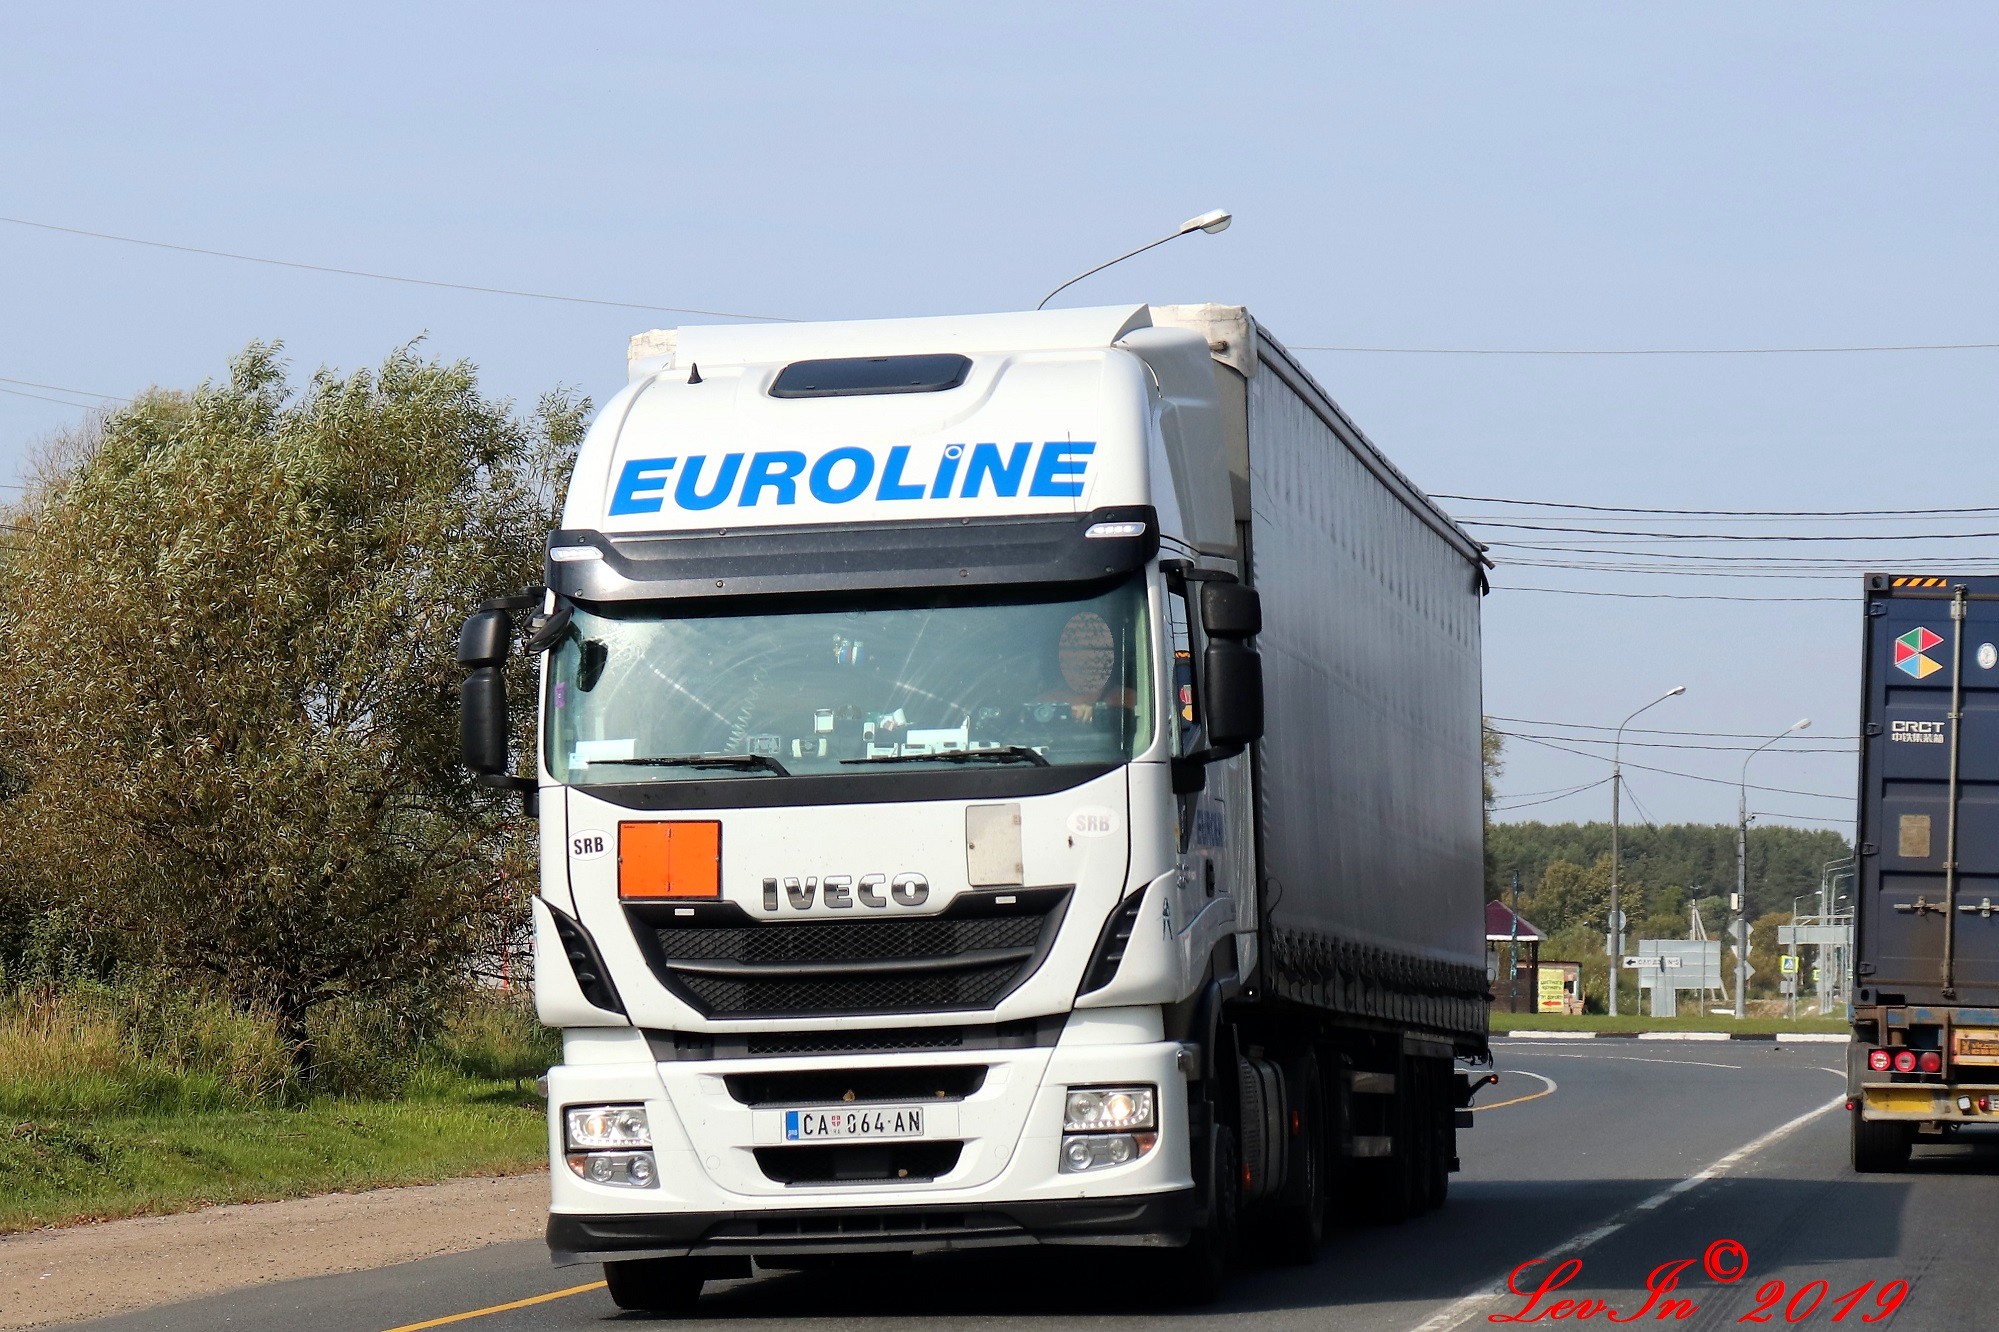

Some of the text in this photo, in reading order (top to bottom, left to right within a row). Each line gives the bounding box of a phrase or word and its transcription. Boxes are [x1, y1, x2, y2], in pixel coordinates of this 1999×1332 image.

[1892, 721, 1945, 733] CRCT
[1076, 814, 1110, 832] SRB
[574, 837, 604, 855] SRB
[762, 872, 930, 911] IVECO
